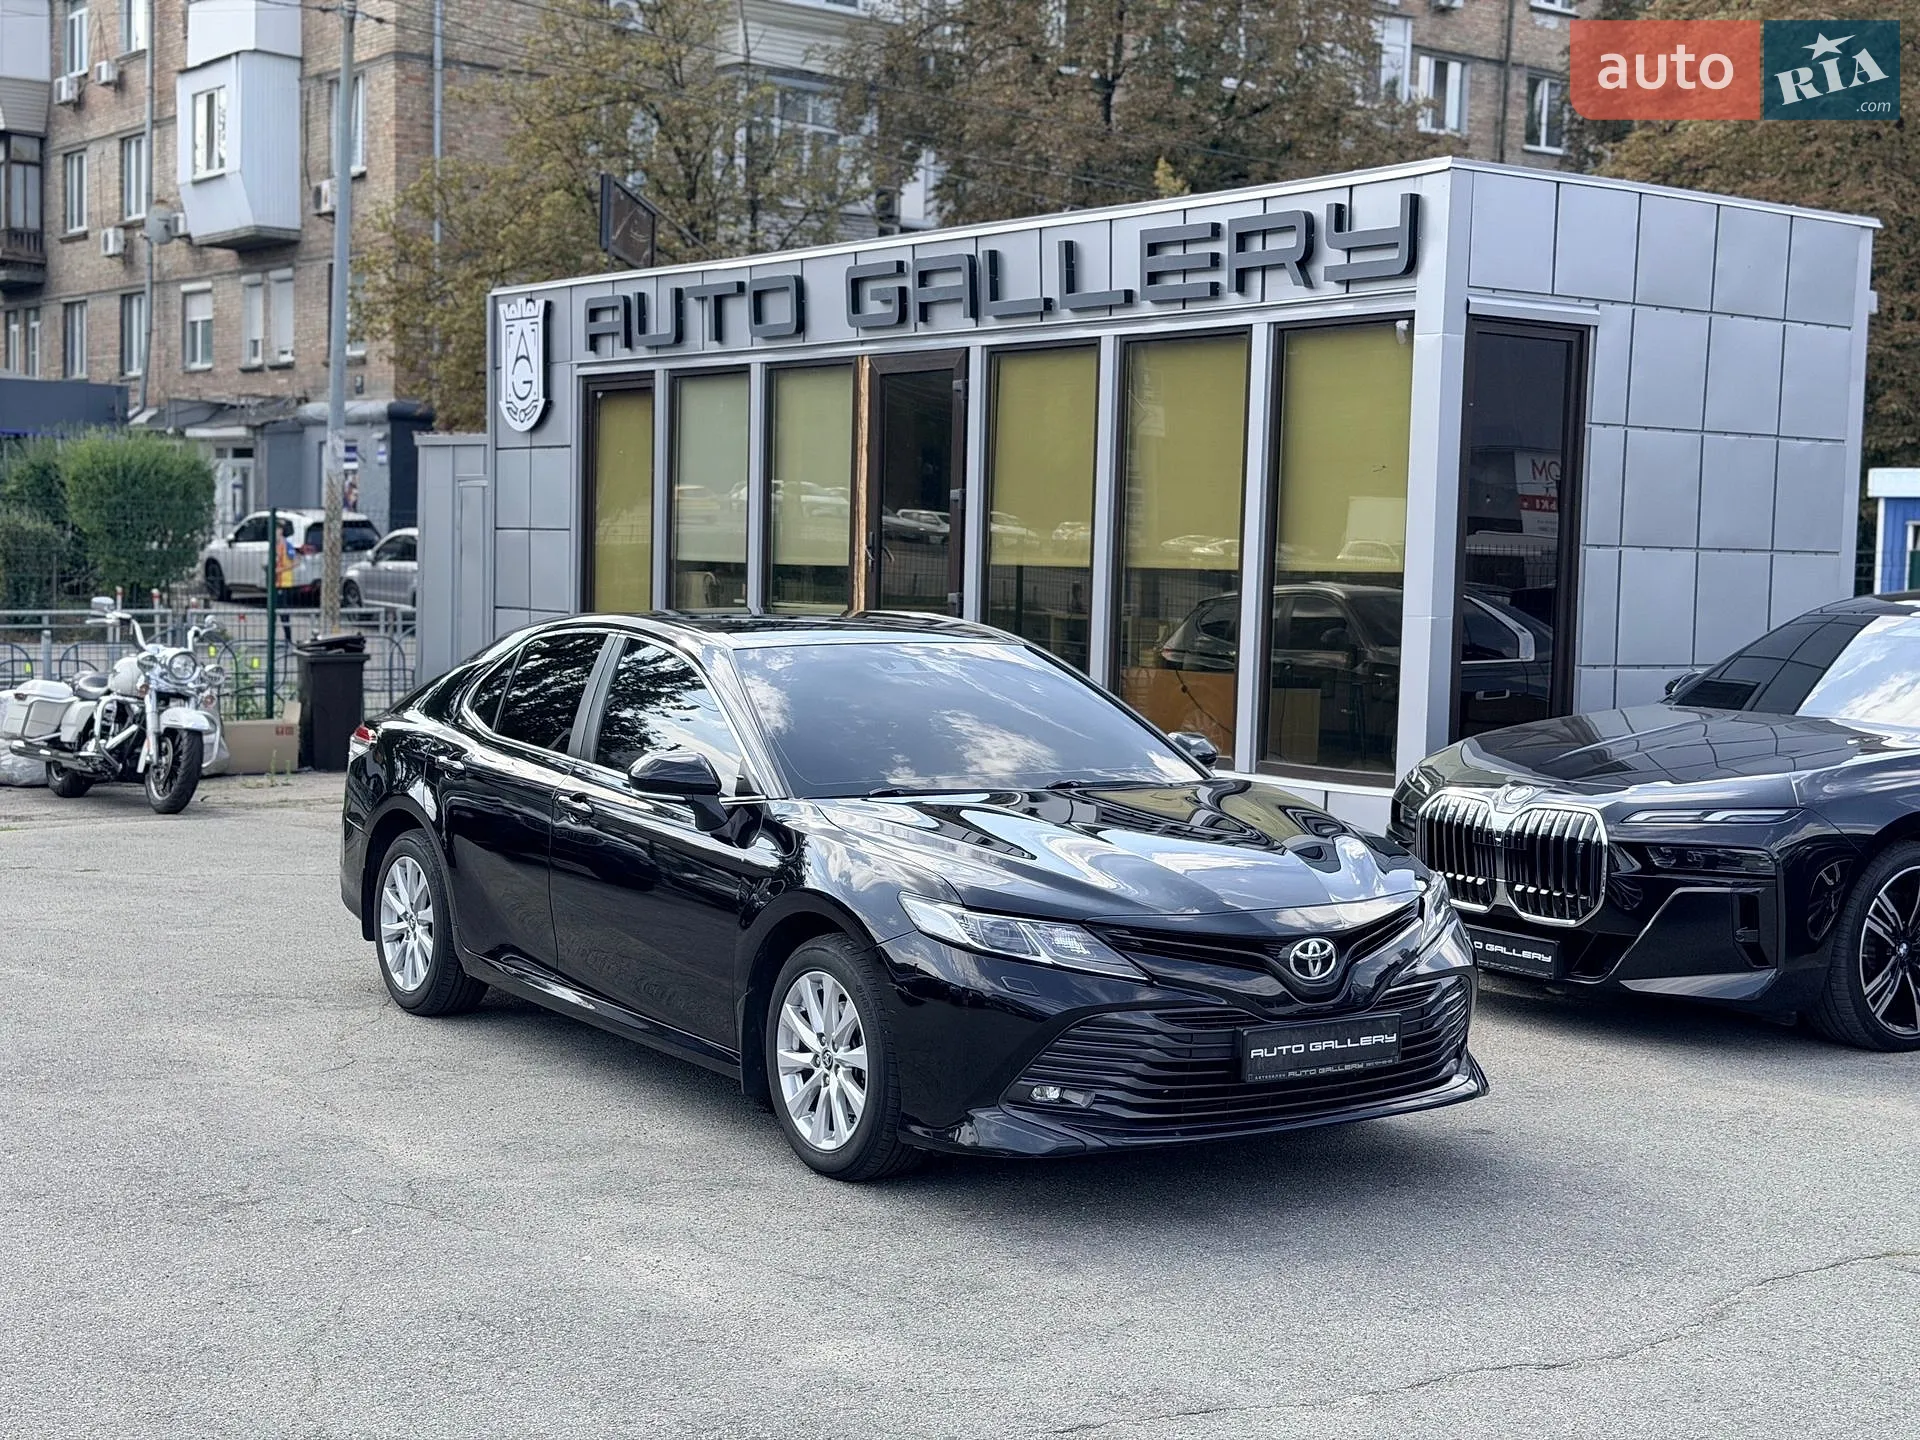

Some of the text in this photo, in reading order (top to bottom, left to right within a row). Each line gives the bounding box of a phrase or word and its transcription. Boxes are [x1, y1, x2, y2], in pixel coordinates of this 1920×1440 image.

[585, 193, 1421, 353] AUTO GALLERY
[1485, 943, 1552, 963] GALLERY
[1250, 1033, 1397, 1059] AUTO GALLERY
[1287, 1068, 1317, 1077] AUTO
[1318, 1062, 1364, 1075] GALLERY
